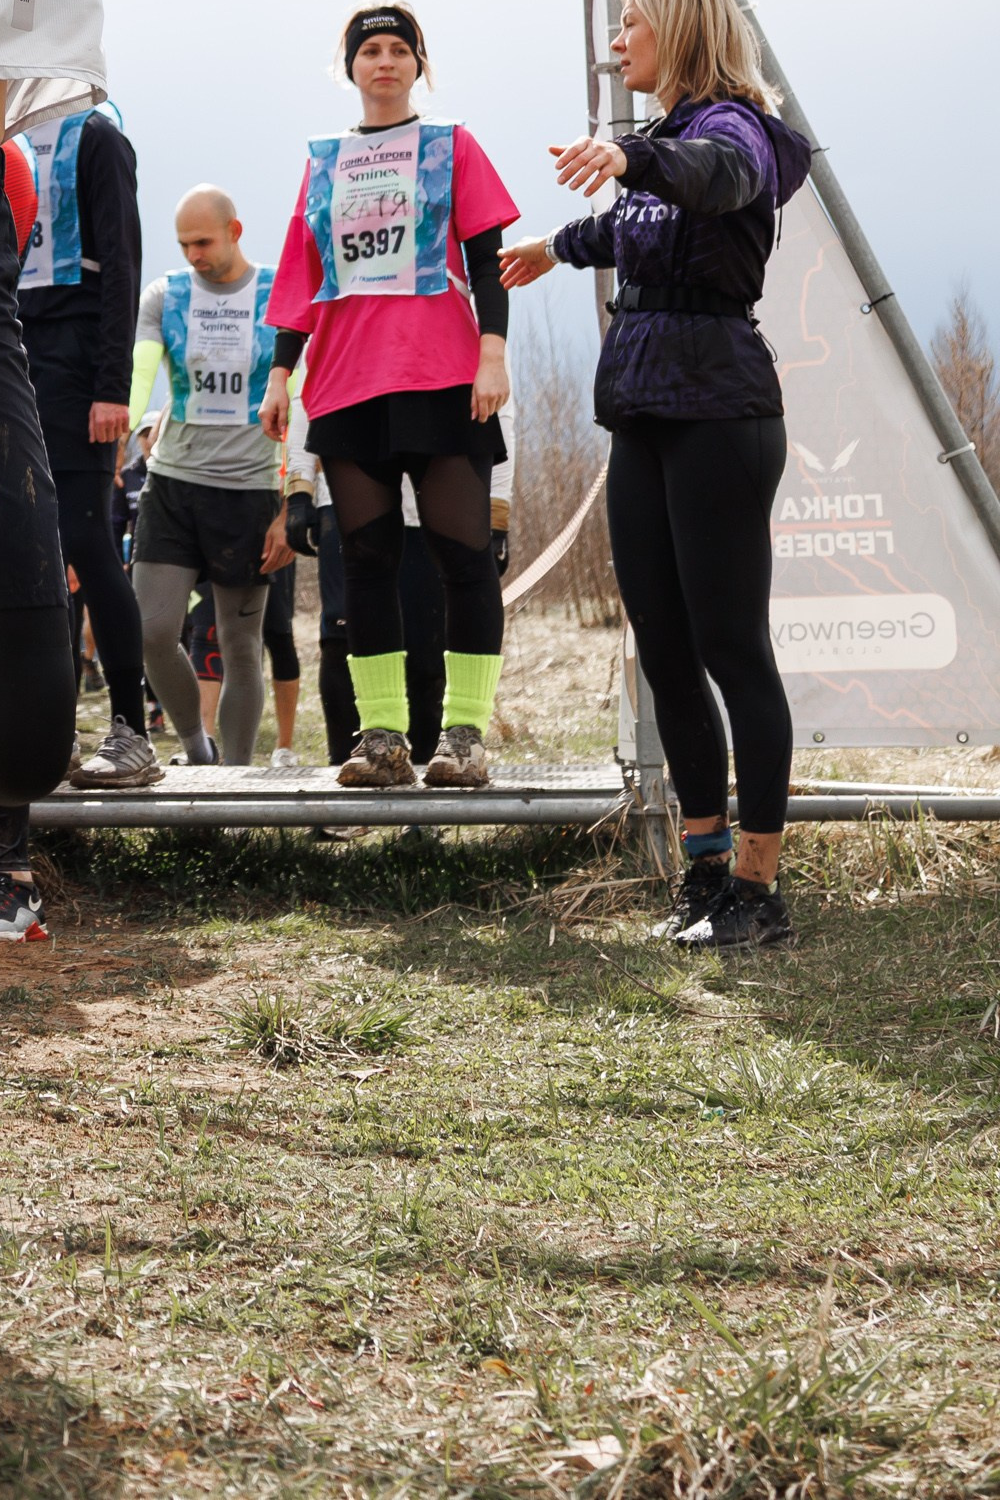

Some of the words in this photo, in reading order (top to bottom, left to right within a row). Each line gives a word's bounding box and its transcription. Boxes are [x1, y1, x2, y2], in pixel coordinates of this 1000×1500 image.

[340, 156, 370, 169] ГОНКА
[374, 151, 412, 161] ГЕРОЕВ
[348, 168, 399, 183] Sminex
[341, 225, 405, 263] 5397
[193, 308, 218, 317] ГОНКА
[200, 321, 240, 332] Sminex
[194, 370, 243, 394] 5410
